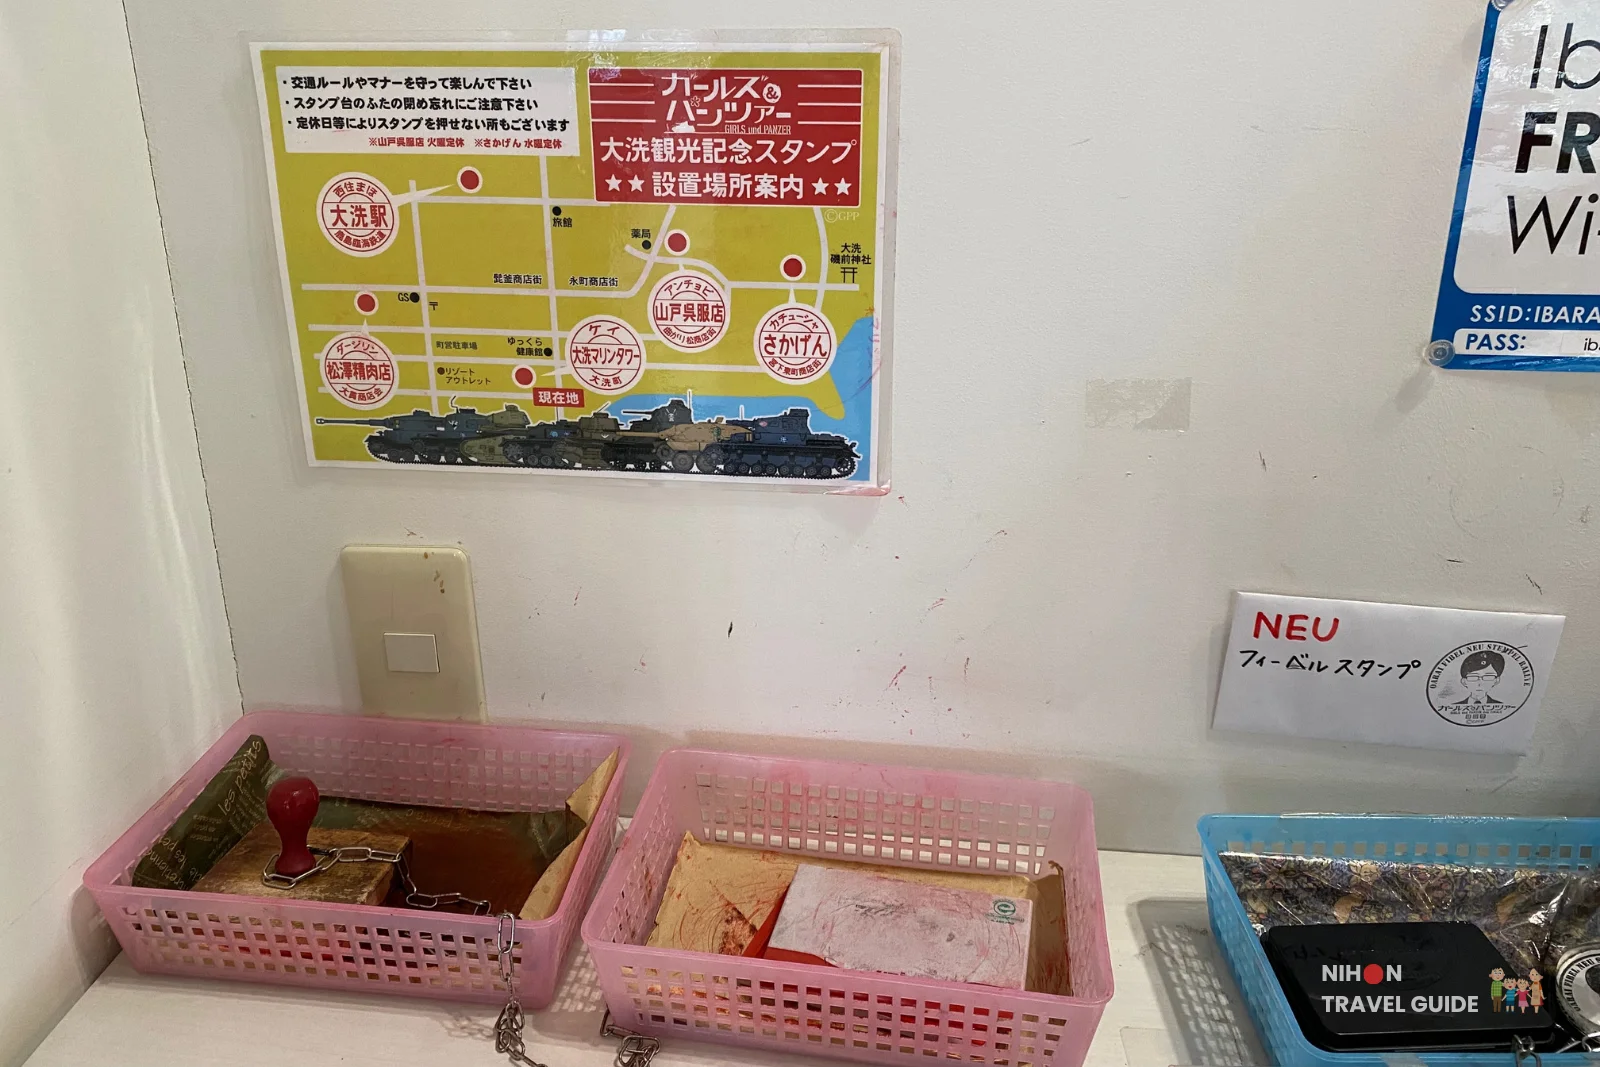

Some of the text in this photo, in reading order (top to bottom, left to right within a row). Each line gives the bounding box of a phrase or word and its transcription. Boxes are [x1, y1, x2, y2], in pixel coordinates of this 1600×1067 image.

[724, 124, 746, 134] GIRLS
[764, 125, 791, 135] PANZER
[1515, 112, 1600, 173] FR
[600, 136, 858, 165] 大洗観光記念スタンプ
[333, 181, 378, 198] 西住まほ
[652, 171, 804, 199] 設置場所案内
[330, 204, 388, 228] 大洗駅
[552, 217, 573, 228] 旅館
[1507, 193, 1600, 256] Wi
[631, 228, 651, 239] 薬局
[841, 243, 861, 253] 大洗
[830, 254, 872, 265] 磯前神社
[569, 277, 618, 287] 永町商店街
[664, 280, 714, 297] アンチョビ
[397, 292, 410, 302] GS
[655, 302, 725, 323] 山戸呉服店
[769, 313, 819, 330] カチューシャ
[336, 340, 379, 355] ダージリン
[436, 341, 478, 350] 町営駐車場
[507, 337, 543, 346] ゆっくら
[764, 334, 827, 357] さかげん
[1465, 333, 1600, 351] PASS: ib
[516, 347, 543, 357] 健康館
[572, 346, 640, 365] 大洗マリンタワー
[446, 367, 475, 376] リゾート
[446, 376, 491, 386] アウトレット
[589, 375, 622, 387] 大洗町
[538, 391, 579, 405] 現在地
[1253, 612, 1339, 642] NEU
[1466, 644, 1484, 653] NEU
